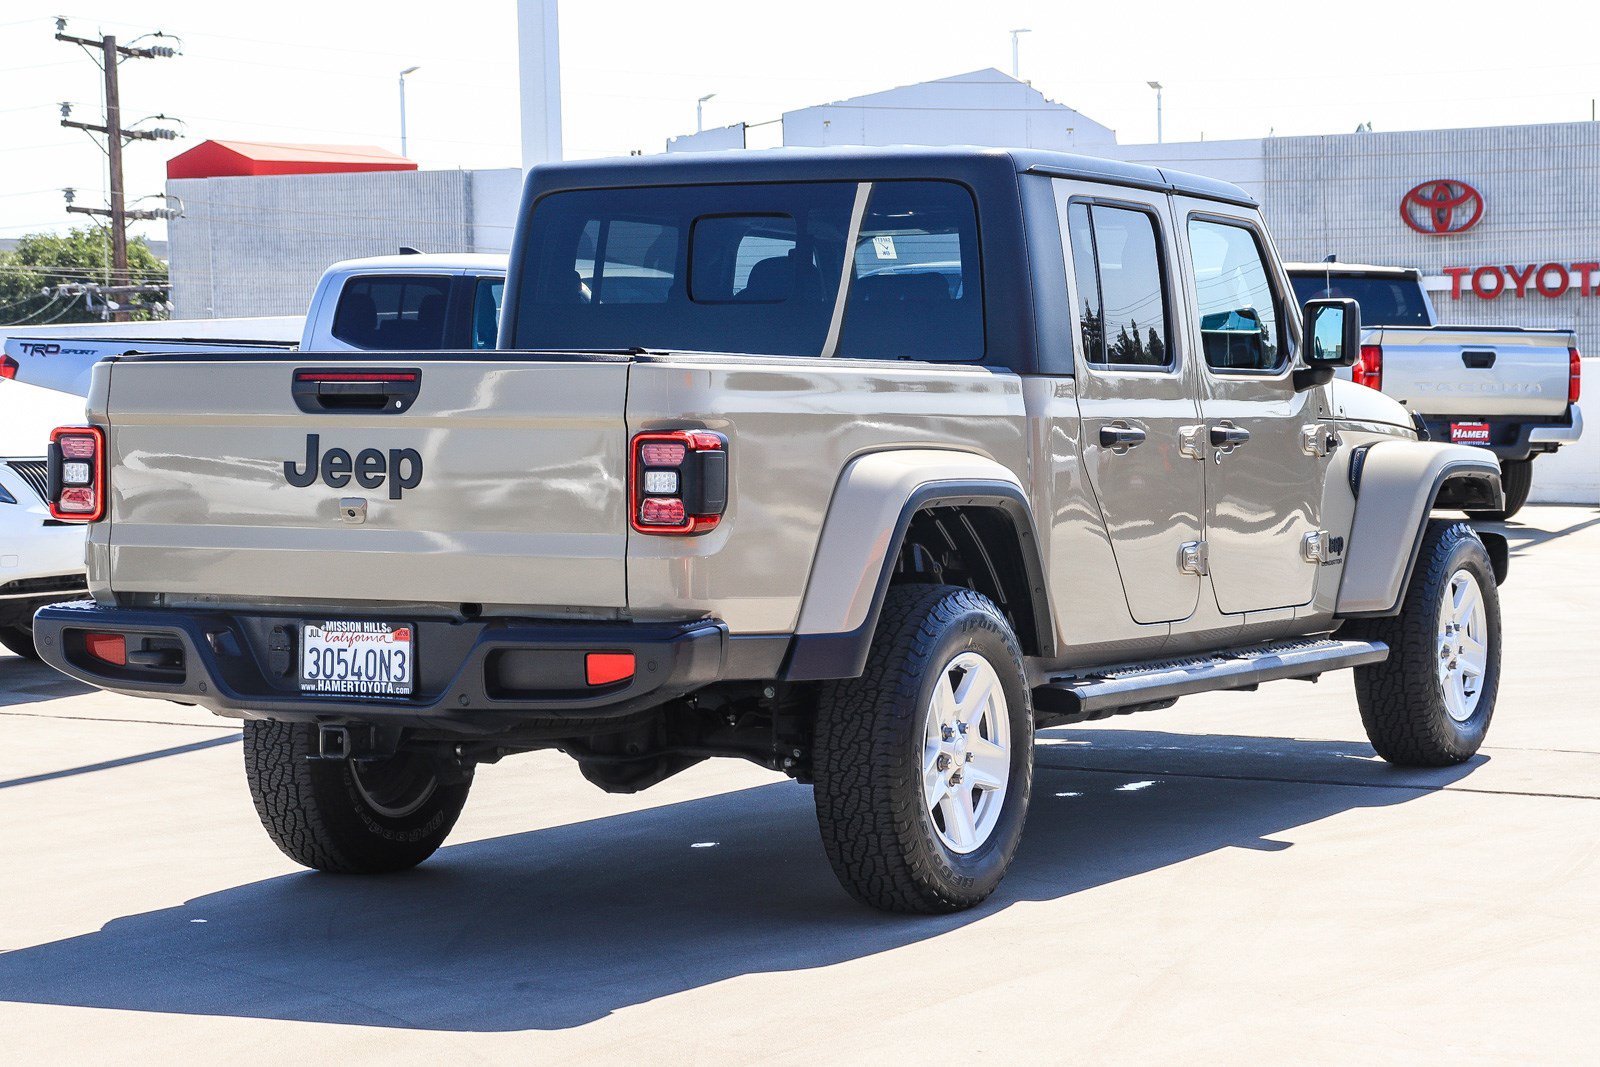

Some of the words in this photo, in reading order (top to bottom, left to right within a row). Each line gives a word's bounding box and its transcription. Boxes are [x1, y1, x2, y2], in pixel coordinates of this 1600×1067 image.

[1443, 262, 1600, 300] TOYOT
[20, 343, 60, 357] TRD
[1452, 428, 1489, 439] HAMER
[283, 434, 424, 500] Jeep
[1328, 534, 1344, 556] eep
[308, 629, 321, 638] JUL
[326, 621, 361, 633] MISSION
[363, 622, 387, 633] HILLS
[324, 631, 394, 648] California
[308, 647, 406, 681] 30540N3
[301, 680, 410, 695] www.HAMERTOYOTA.com
